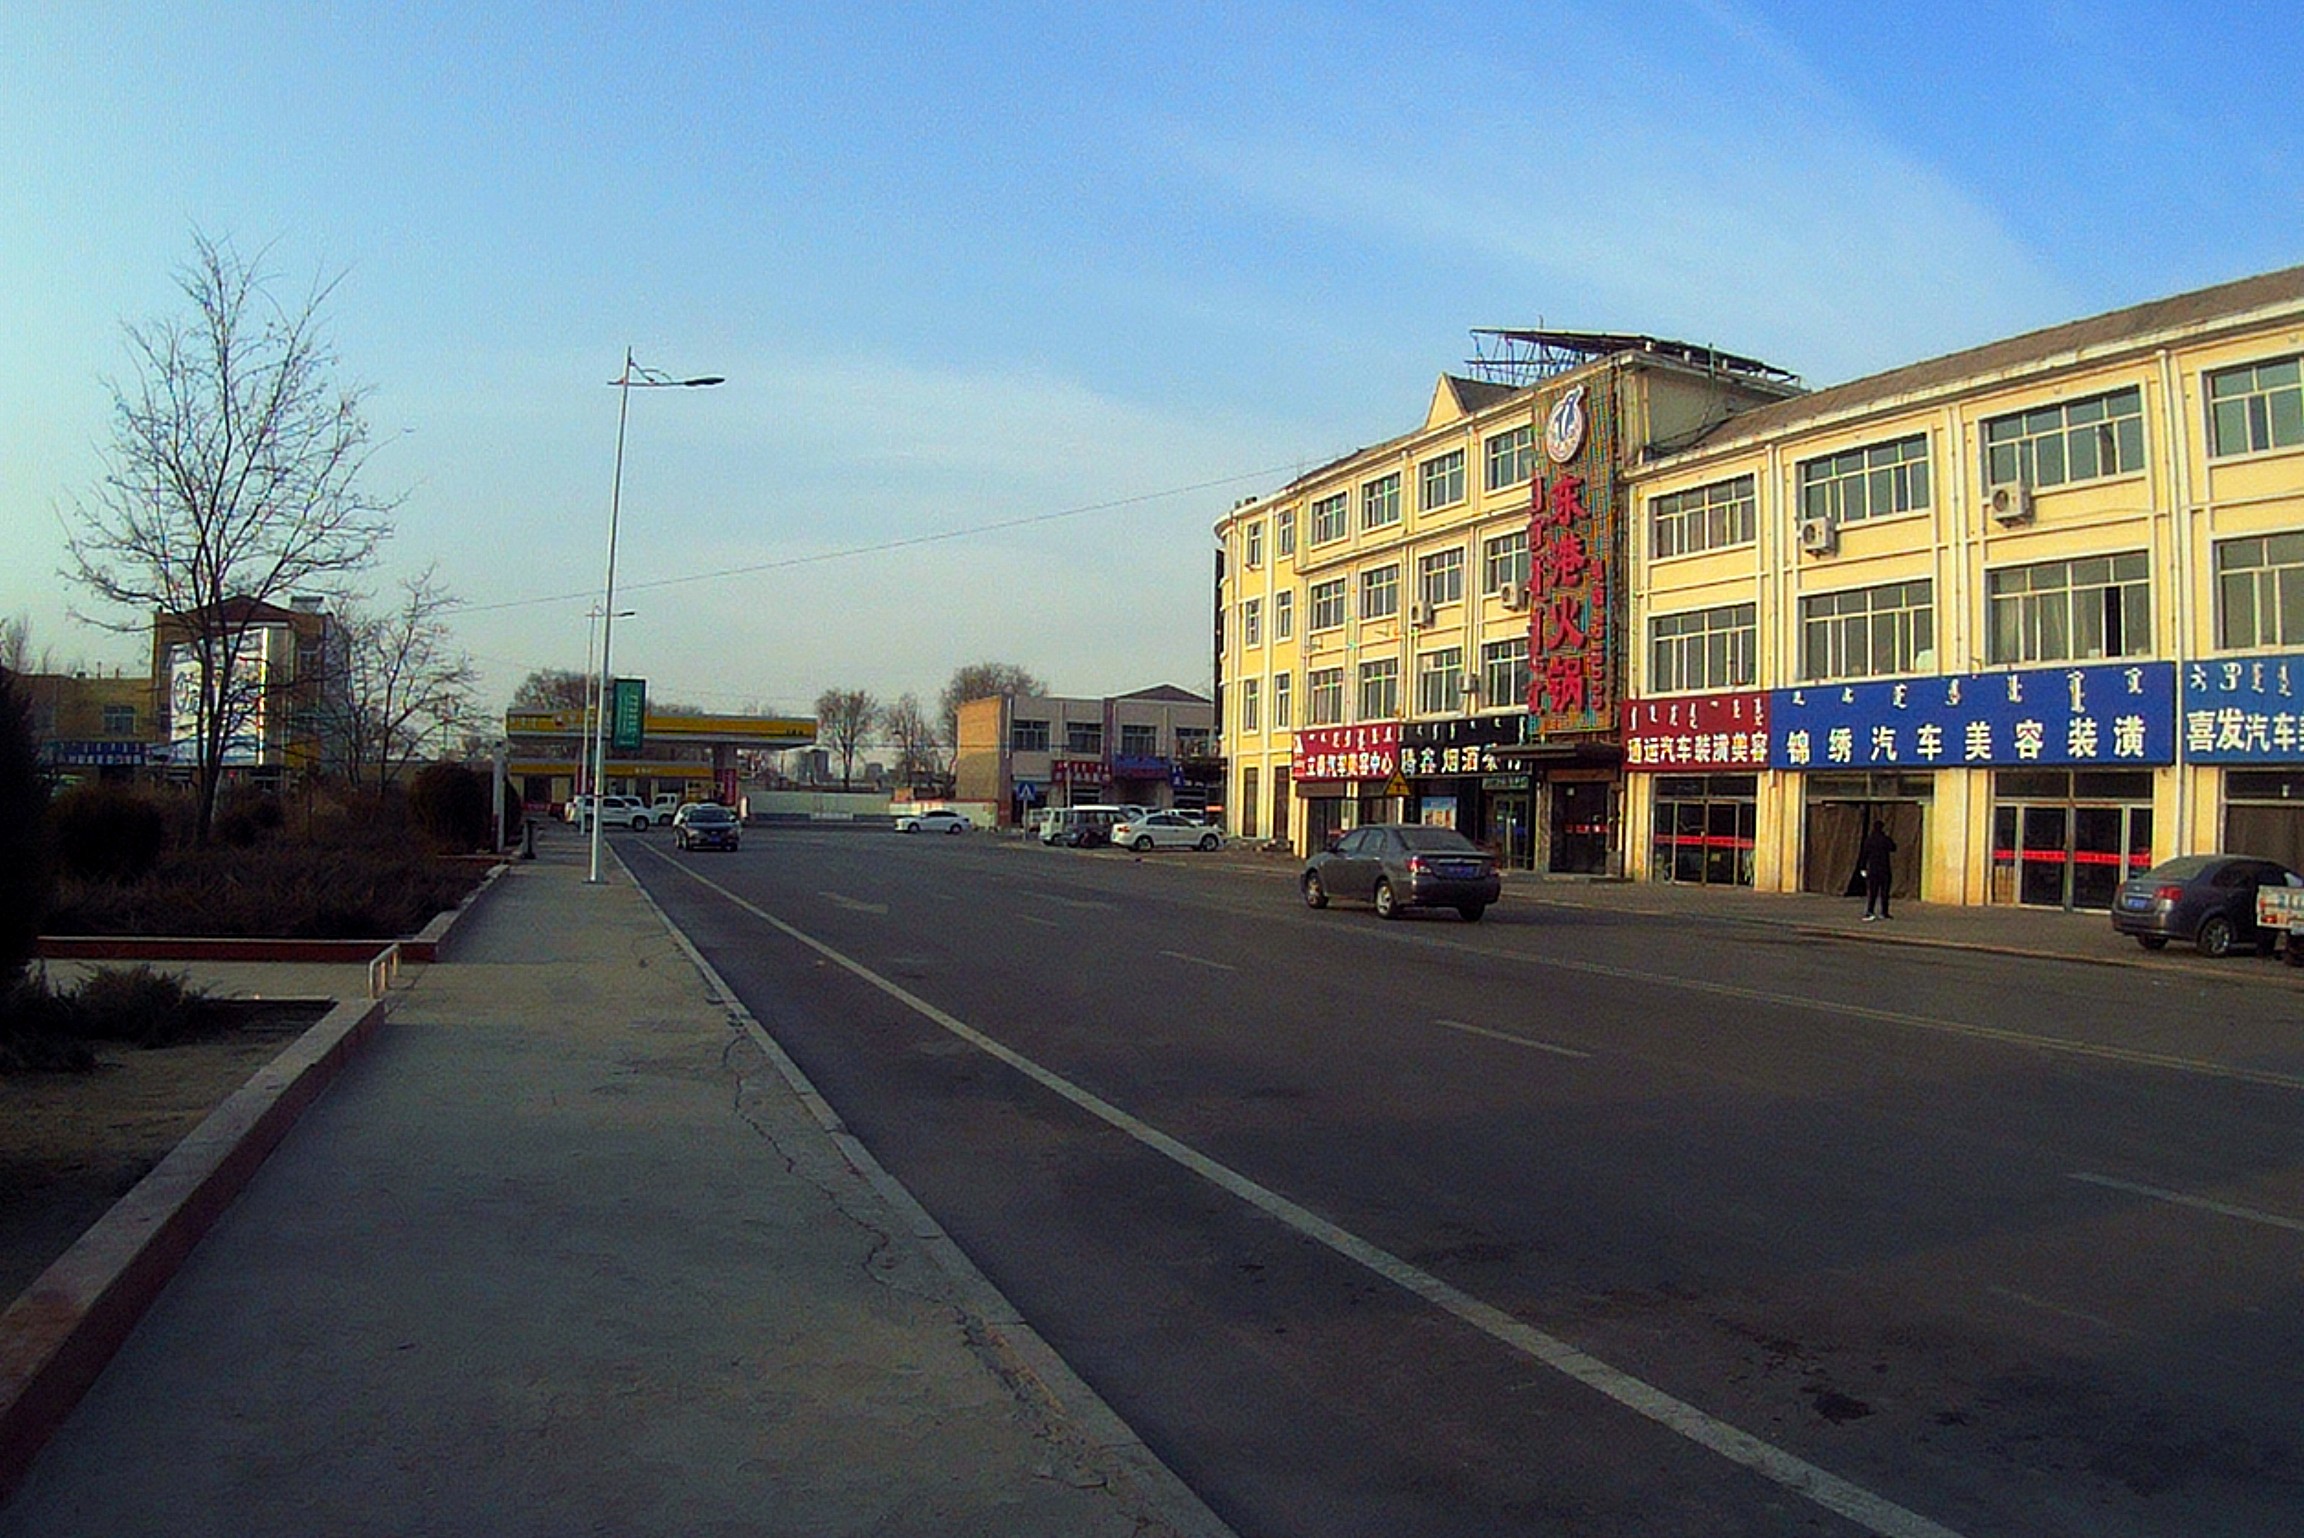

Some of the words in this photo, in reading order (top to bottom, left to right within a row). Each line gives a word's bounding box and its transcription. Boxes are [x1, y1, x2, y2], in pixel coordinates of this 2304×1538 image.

[1545, 475, 1590, 713] 东港火锅
[1626, 730, 1768, 763] 通运汽车装潢美容
[1786, 714, 2145, 765] 锦绣汽车美容装潢
[2186, 707, 2304, 752] 喜发汽车
